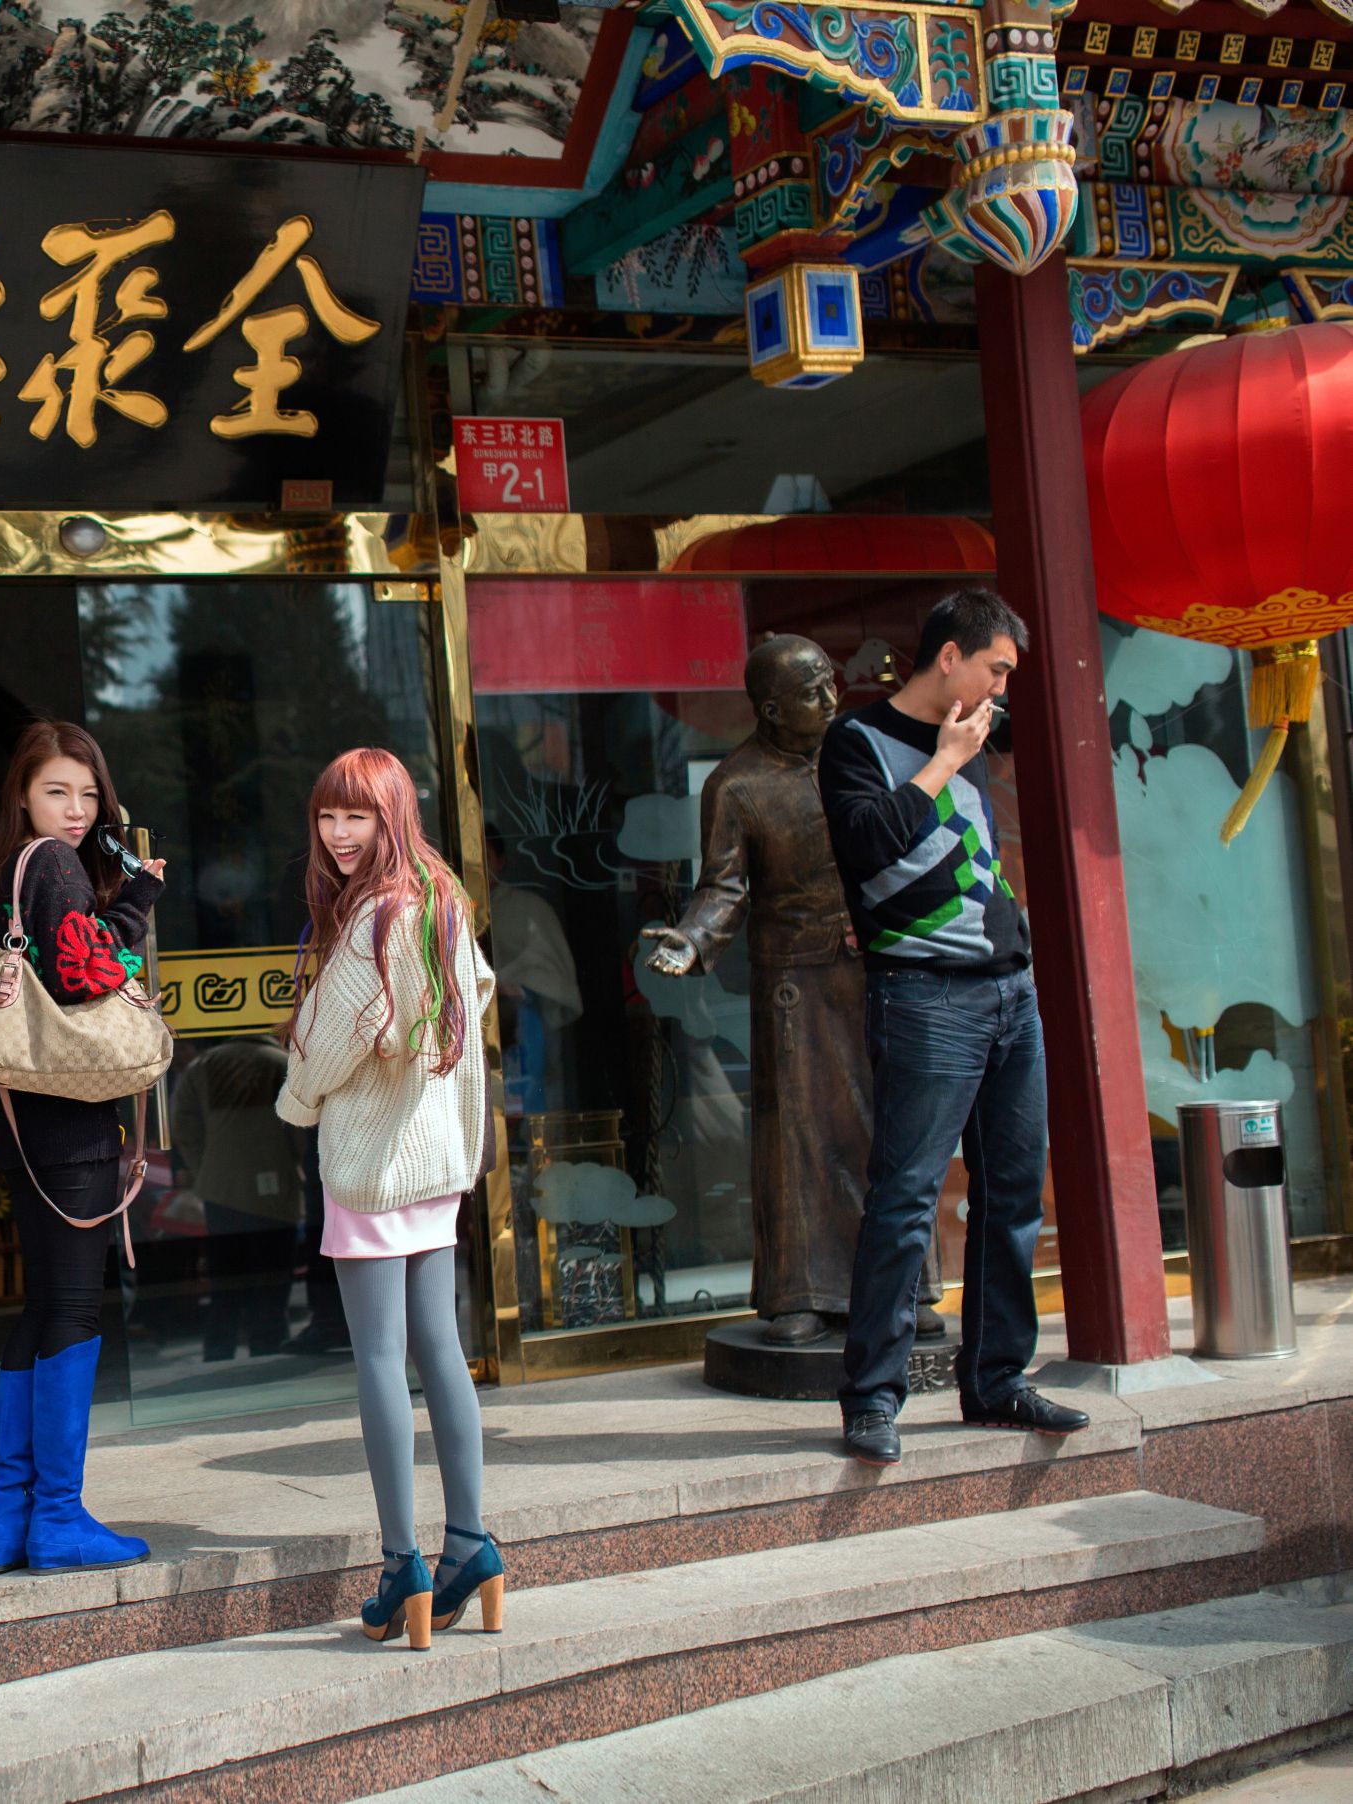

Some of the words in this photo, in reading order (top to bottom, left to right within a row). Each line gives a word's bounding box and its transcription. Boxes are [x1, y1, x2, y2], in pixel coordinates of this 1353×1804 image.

[461, 423, 554, 448] 东三环北路
